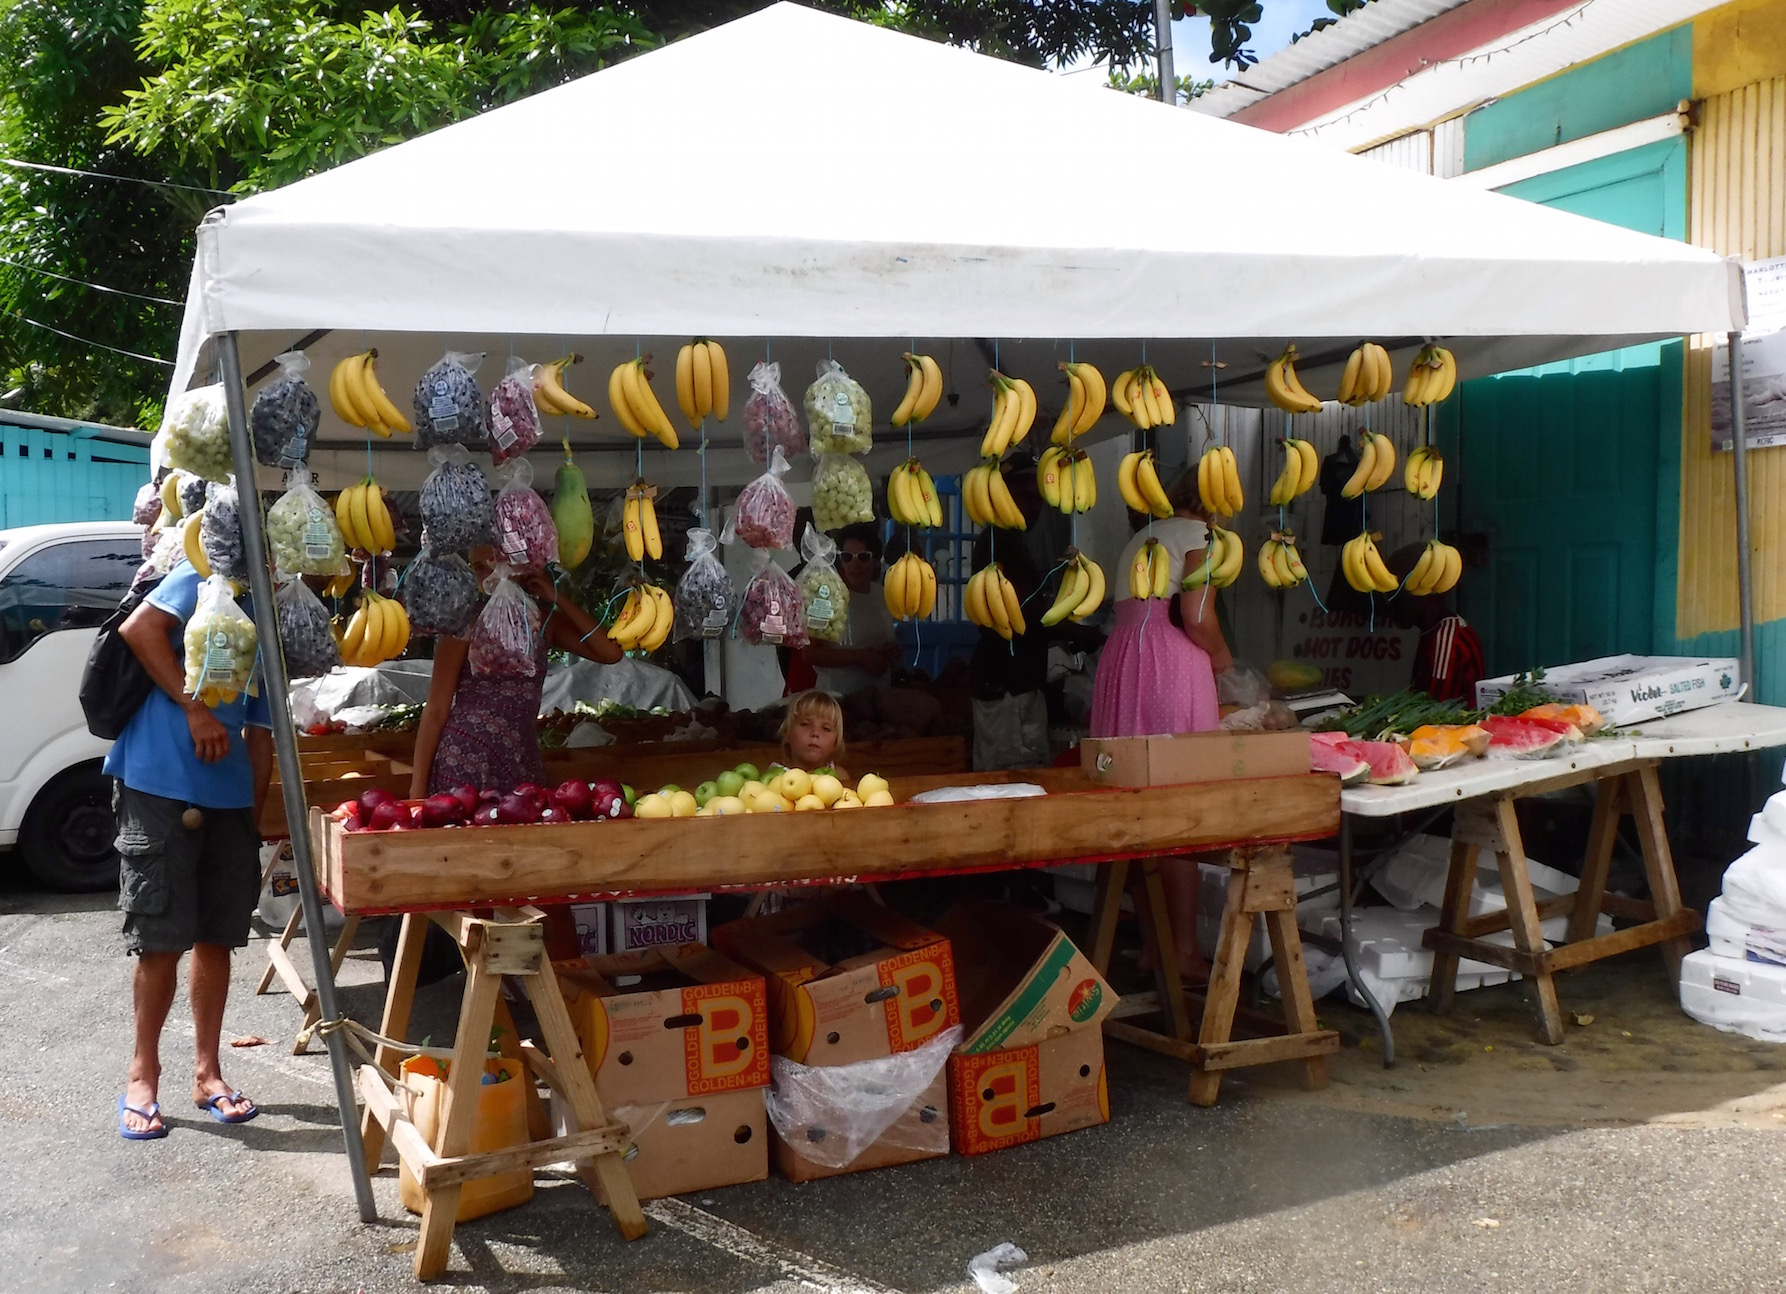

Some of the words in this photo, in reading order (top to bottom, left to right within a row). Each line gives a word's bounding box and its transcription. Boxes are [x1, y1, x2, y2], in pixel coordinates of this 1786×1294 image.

[1303, 637, 1343, 658] HOT
[1345, 636, 1401, 660] DOGS
[628, 920, 696, 947] NORDIC
[878, 949, 929, 974] GOLDEN
[683, 984, 740, 1000] GOLDEN
[944, 973, 960, 1026] GOLDEN
[696, 996, 755, 1080] B
[754, 1013, 768, 1071] GOLDEN
[987, 1048, 1038, 1065] GOLDEN
[688, 1075, 745, 1093] GOLDEN
[964, 1069, 977, 1124] GOLDEN
[990, 1129, 1039, 1147] GOLDEN
